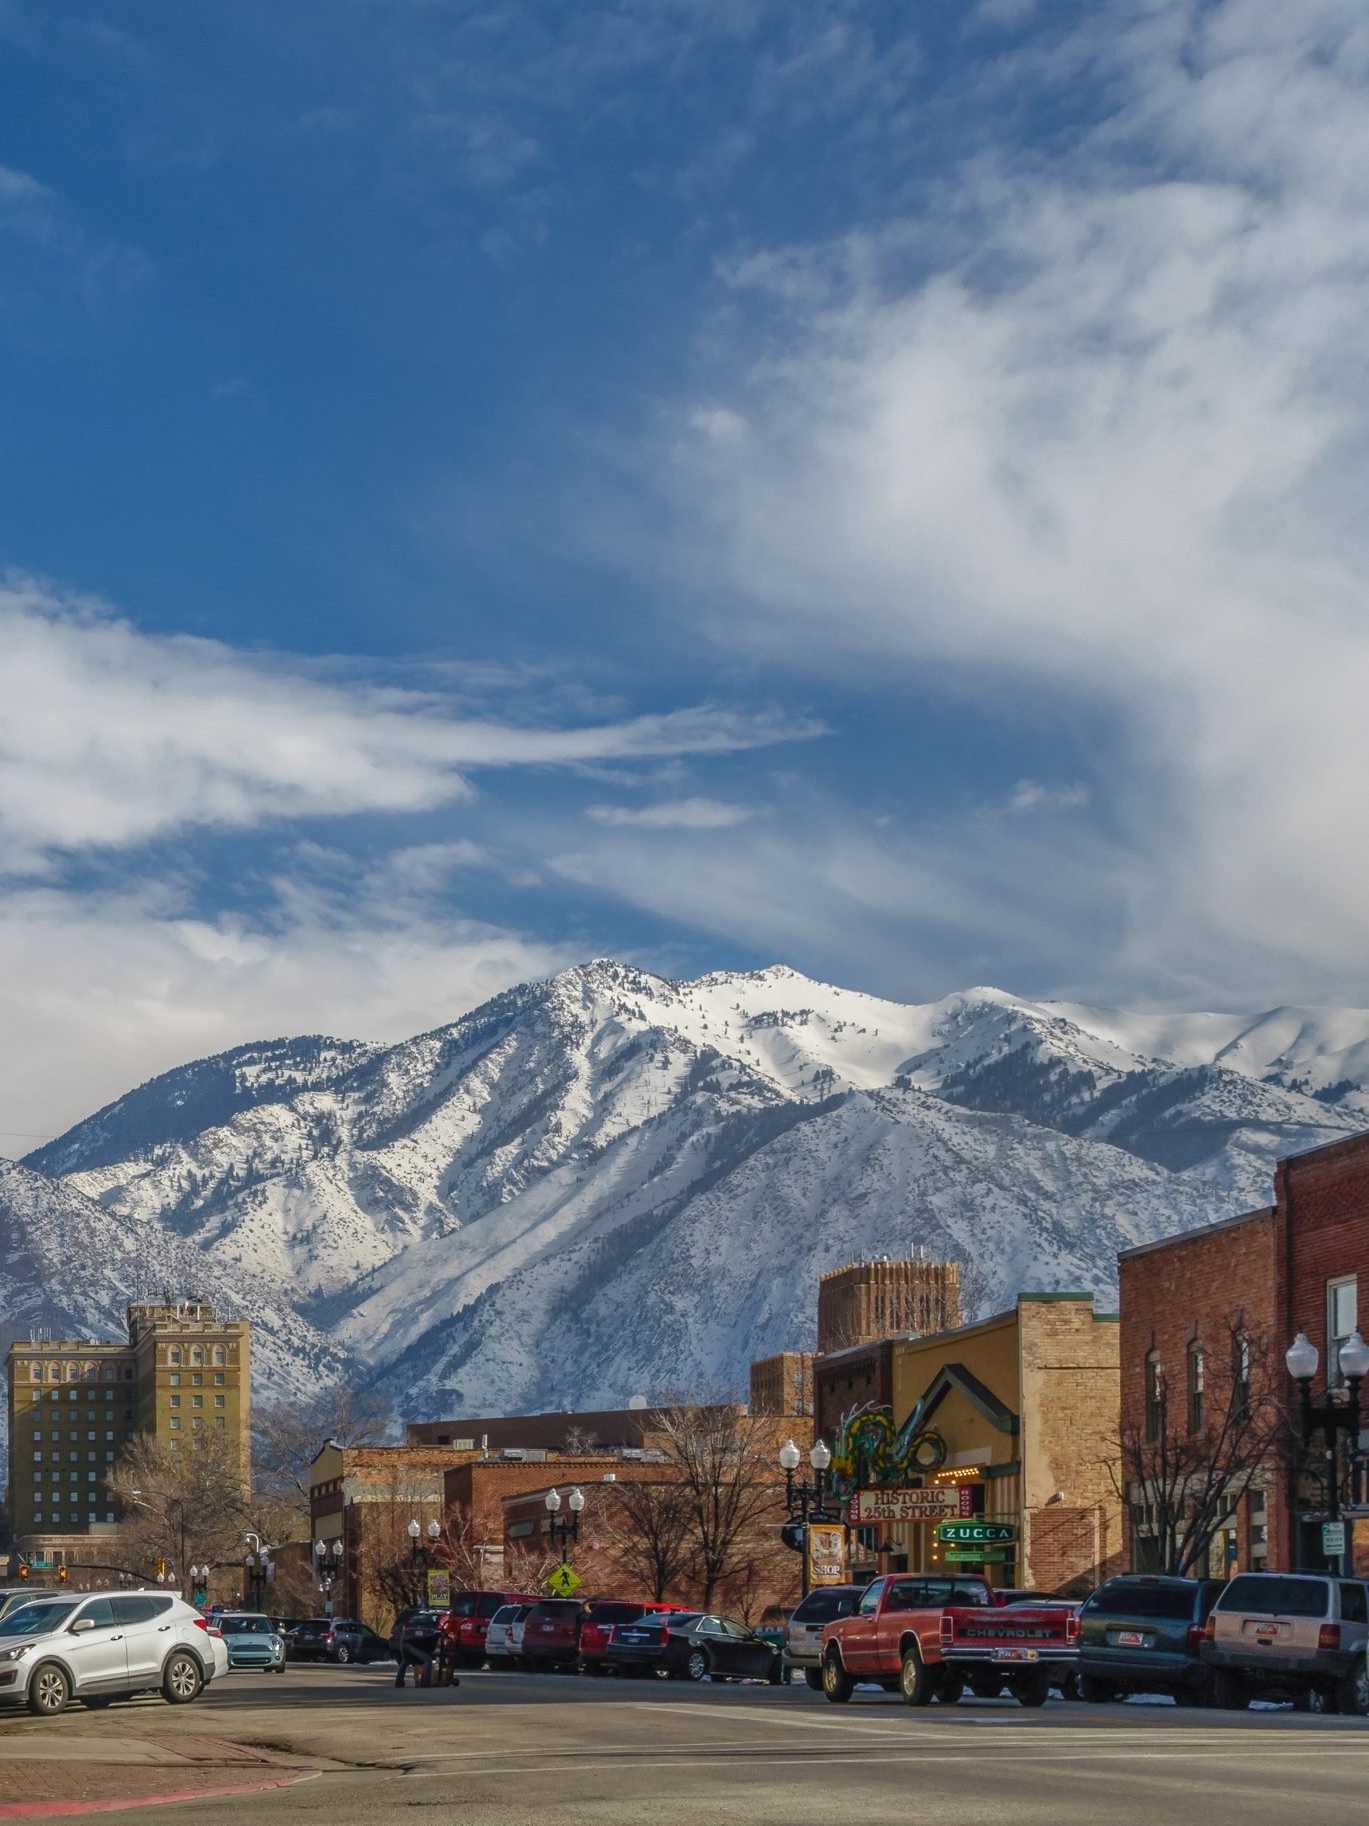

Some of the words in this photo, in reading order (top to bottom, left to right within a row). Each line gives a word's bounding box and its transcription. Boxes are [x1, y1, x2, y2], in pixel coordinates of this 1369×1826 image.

[874, 1490, 946, 1506] HISTORIC
[960, 1489, 970, 1517] ROOMS
[864, 1505, 896, 1519] 25th
[899, 1504, 958, 1519] STREET
[946, 1528, 1009, 1538] ZUCCA
[815, 1565, 840, 1575] SHOP
[966, 1629, 1052, 1638] CHEVROLET
